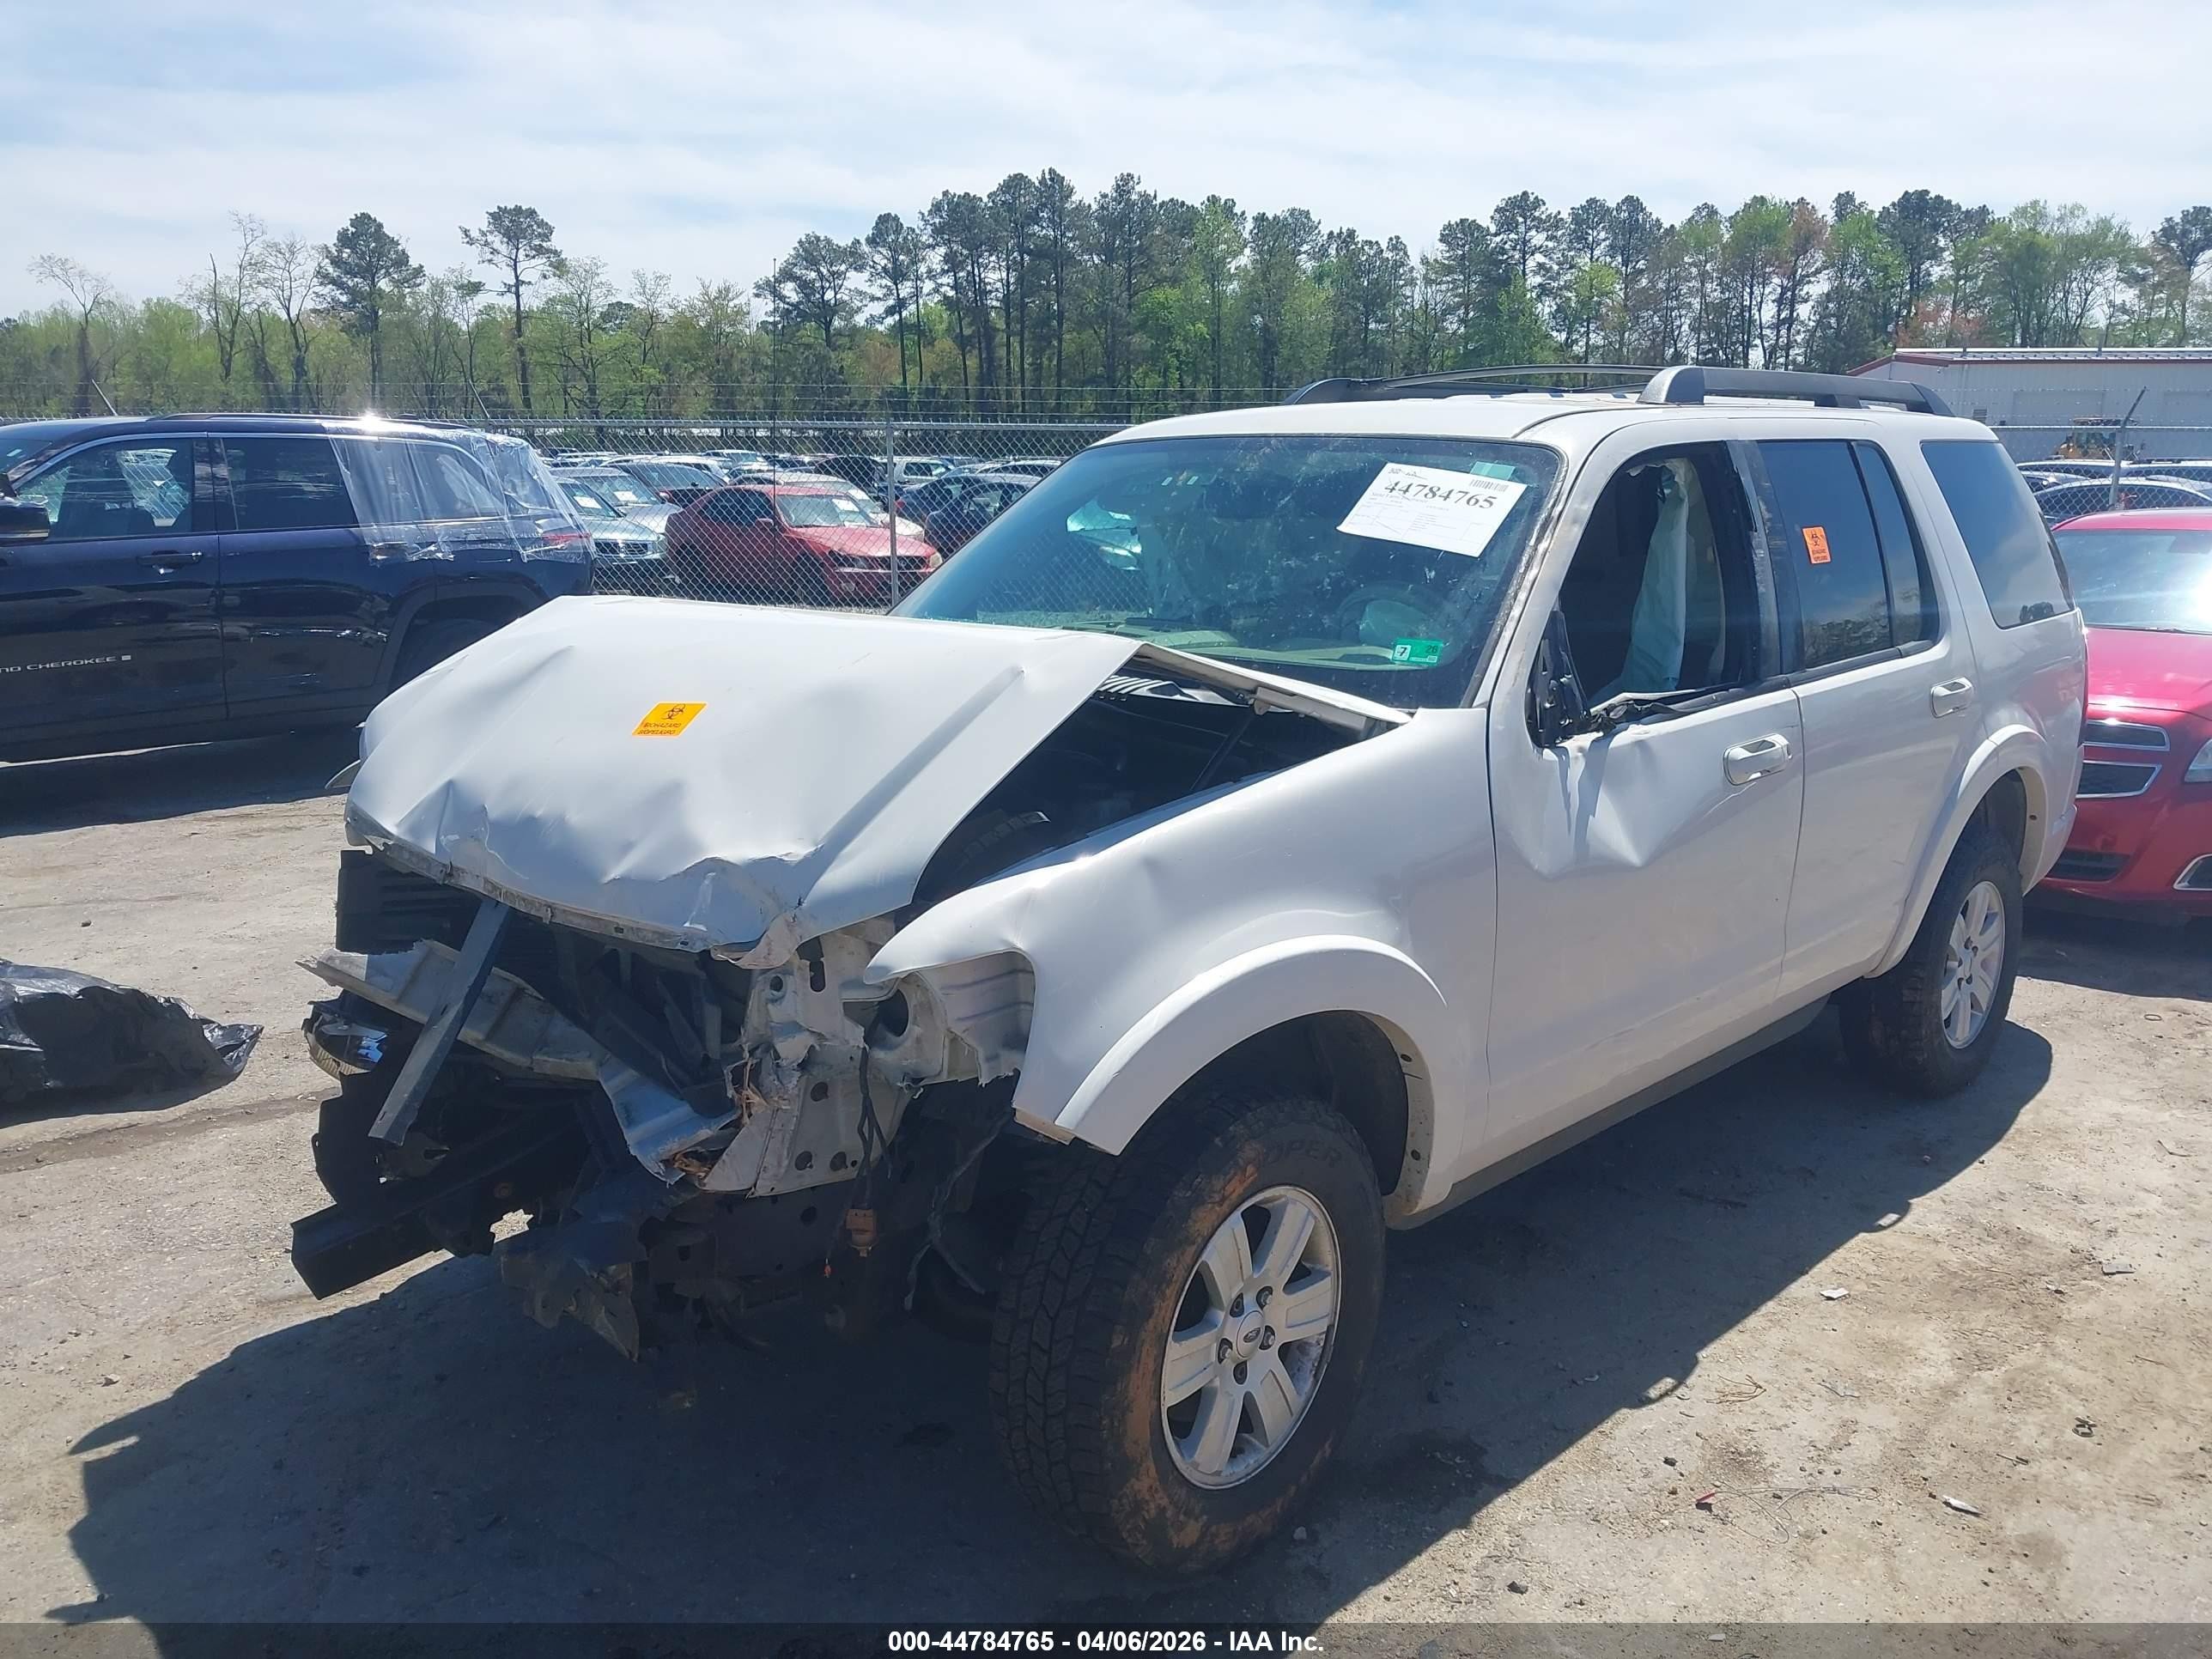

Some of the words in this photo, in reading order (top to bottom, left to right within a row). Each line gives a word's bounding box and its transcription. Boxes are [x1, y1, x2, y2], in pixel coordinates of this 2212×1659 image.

[1384, 480, 1498, 509] 44784765
[1399, 647, 1407, 657] 7
[27, 656, 117, 670] CHEROKEE
